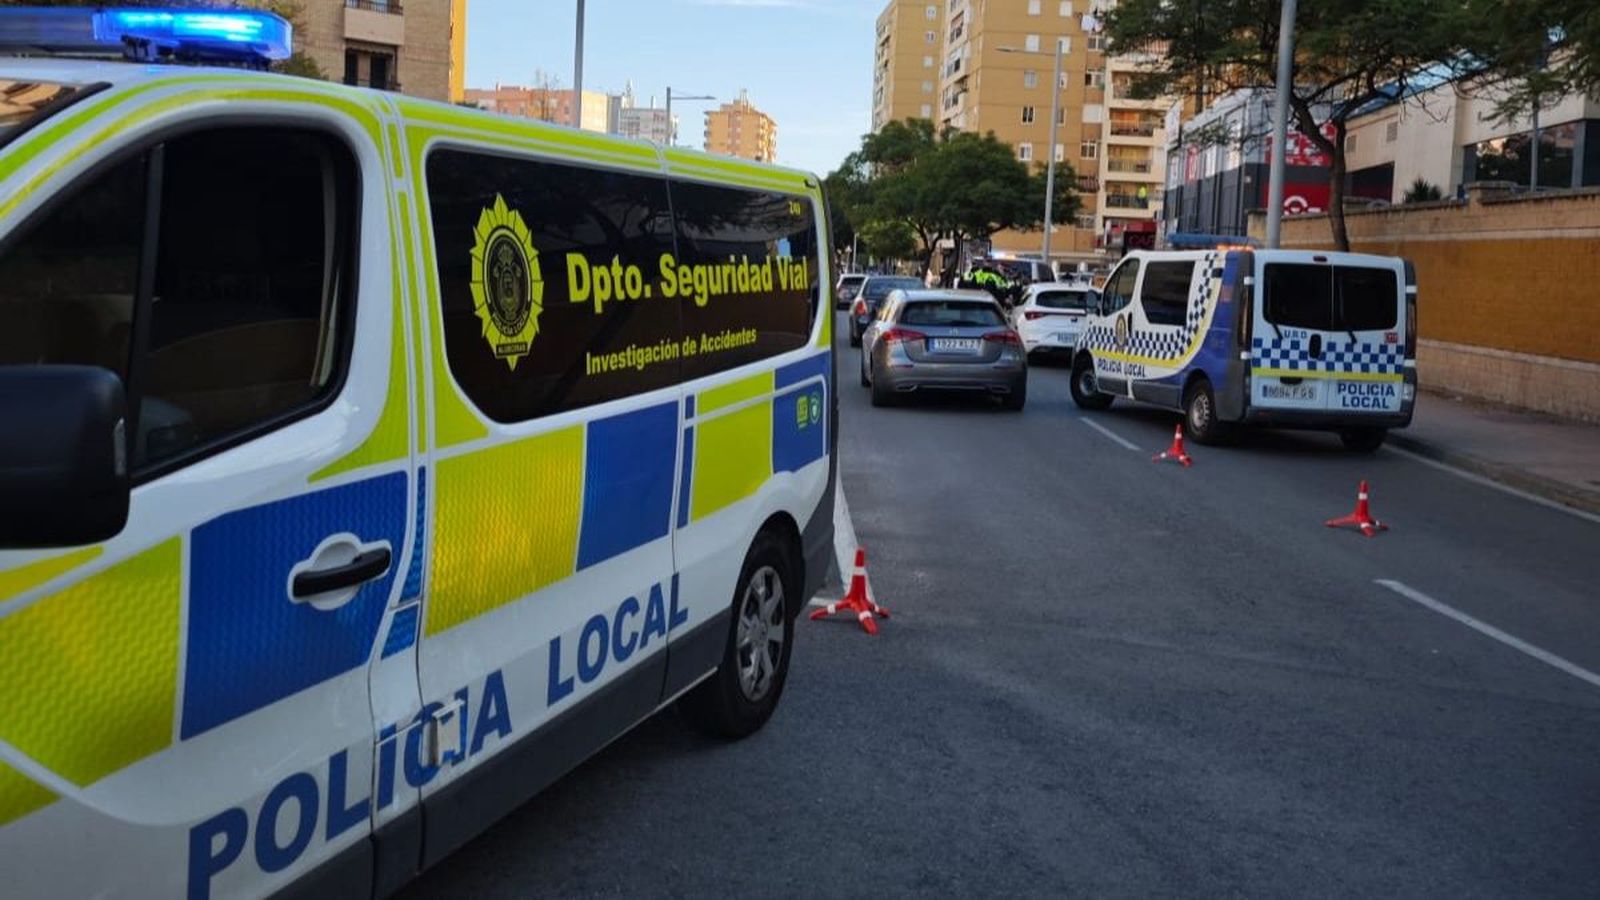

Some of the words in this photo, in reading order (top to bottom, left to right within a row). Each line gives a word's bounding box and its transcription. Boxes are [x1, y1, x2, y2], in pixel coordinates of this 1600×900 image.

[567, 253, 651, 313] Dpto.
[659, 253, 773, 306] Seguridad
[777, 254, 808, 291] Vial
[586, 339, 680, 375] Investigación
[683, 336, 697, 355] de
[700, 327, 757, 353] Accidentes
[1098, 358, 1121, 373] POLICIA
[1124, 362, 1146, 378] LOCAL
[1338, 383, 1395, 397] POLICIA
[1342, 395, 1389, 409] LOCAL
[547, 573, 689, 707] LOCAL
